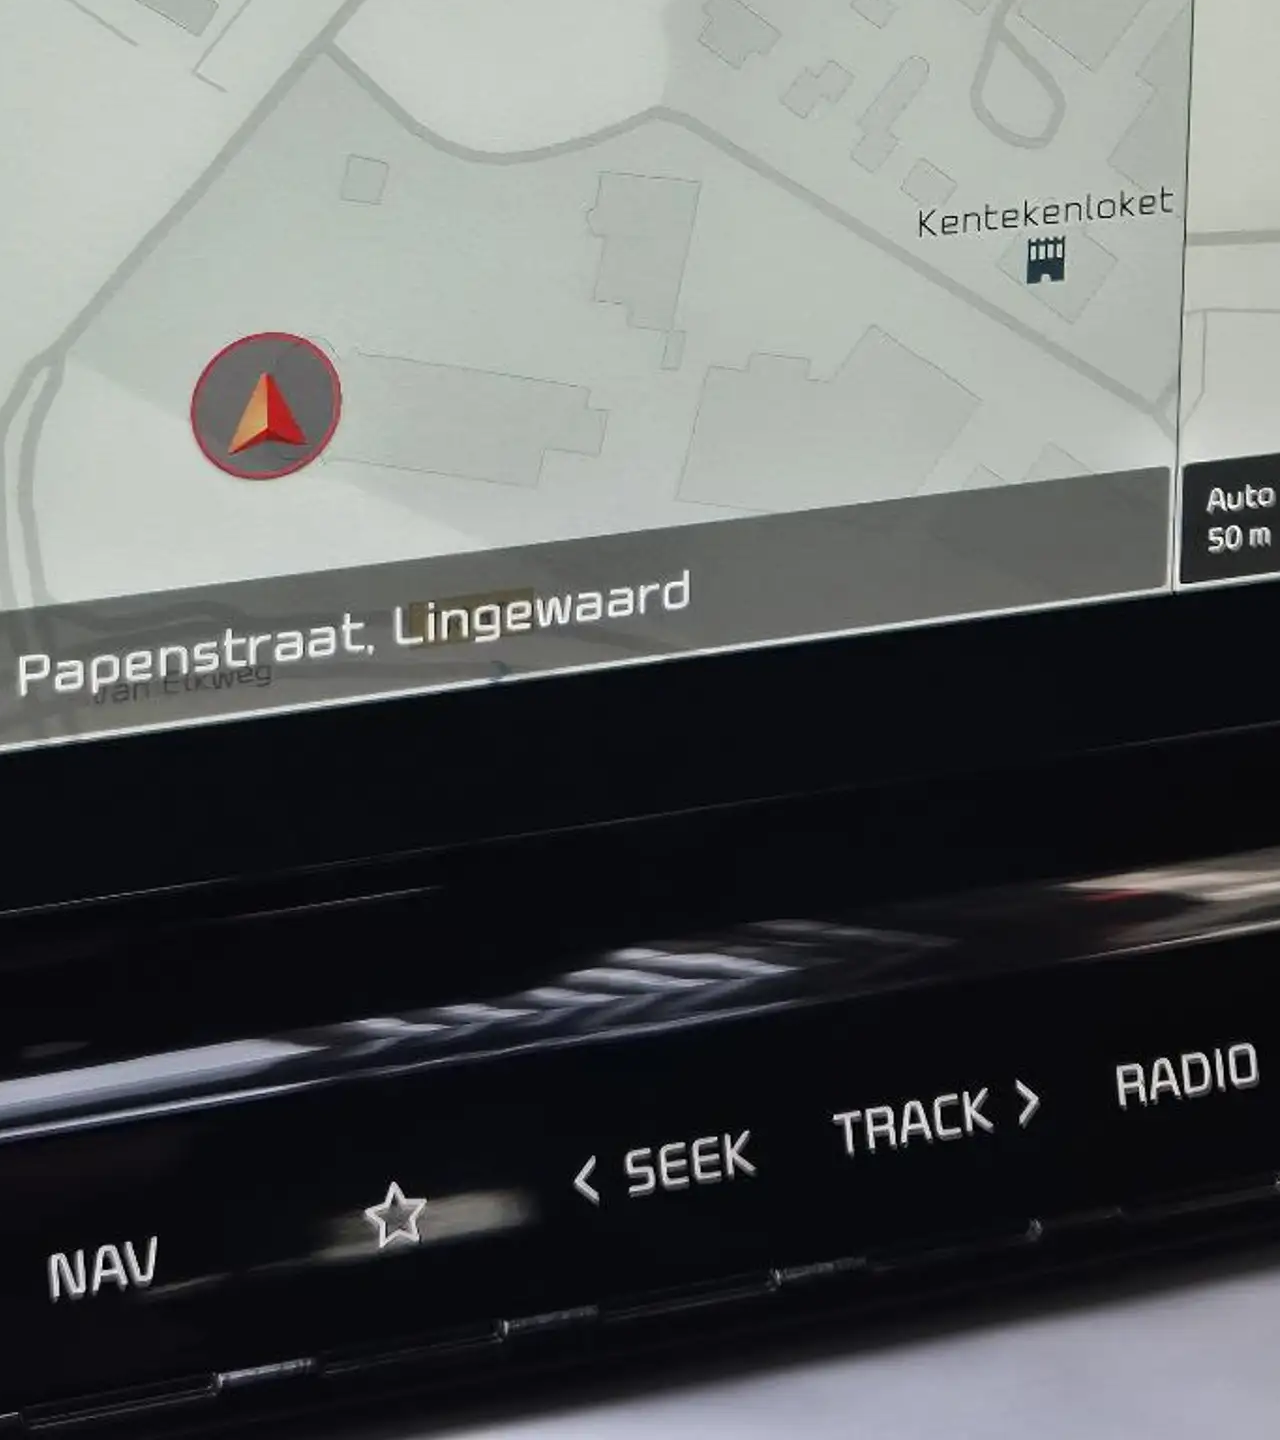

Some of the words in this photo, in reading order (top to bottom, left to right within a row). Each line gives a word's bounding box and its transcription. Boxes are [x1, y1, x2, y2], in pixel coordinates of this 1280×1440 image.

[918, 185, 1175, 238] Kentekenloket
[1205, 483, 1277, 515] Auto
[1207, 524, 1244, 554] 50
[1248, 526, 1272, 549] m
[393, 569, 691, 646] Lingewaard
[1115, 1042, 1260, 1109] RADIO
[832, 1087, 994, 1157] TRACK
[625, 1130, 757, 1197] SEEK
[48, 1235, 159, 1302] NAV
